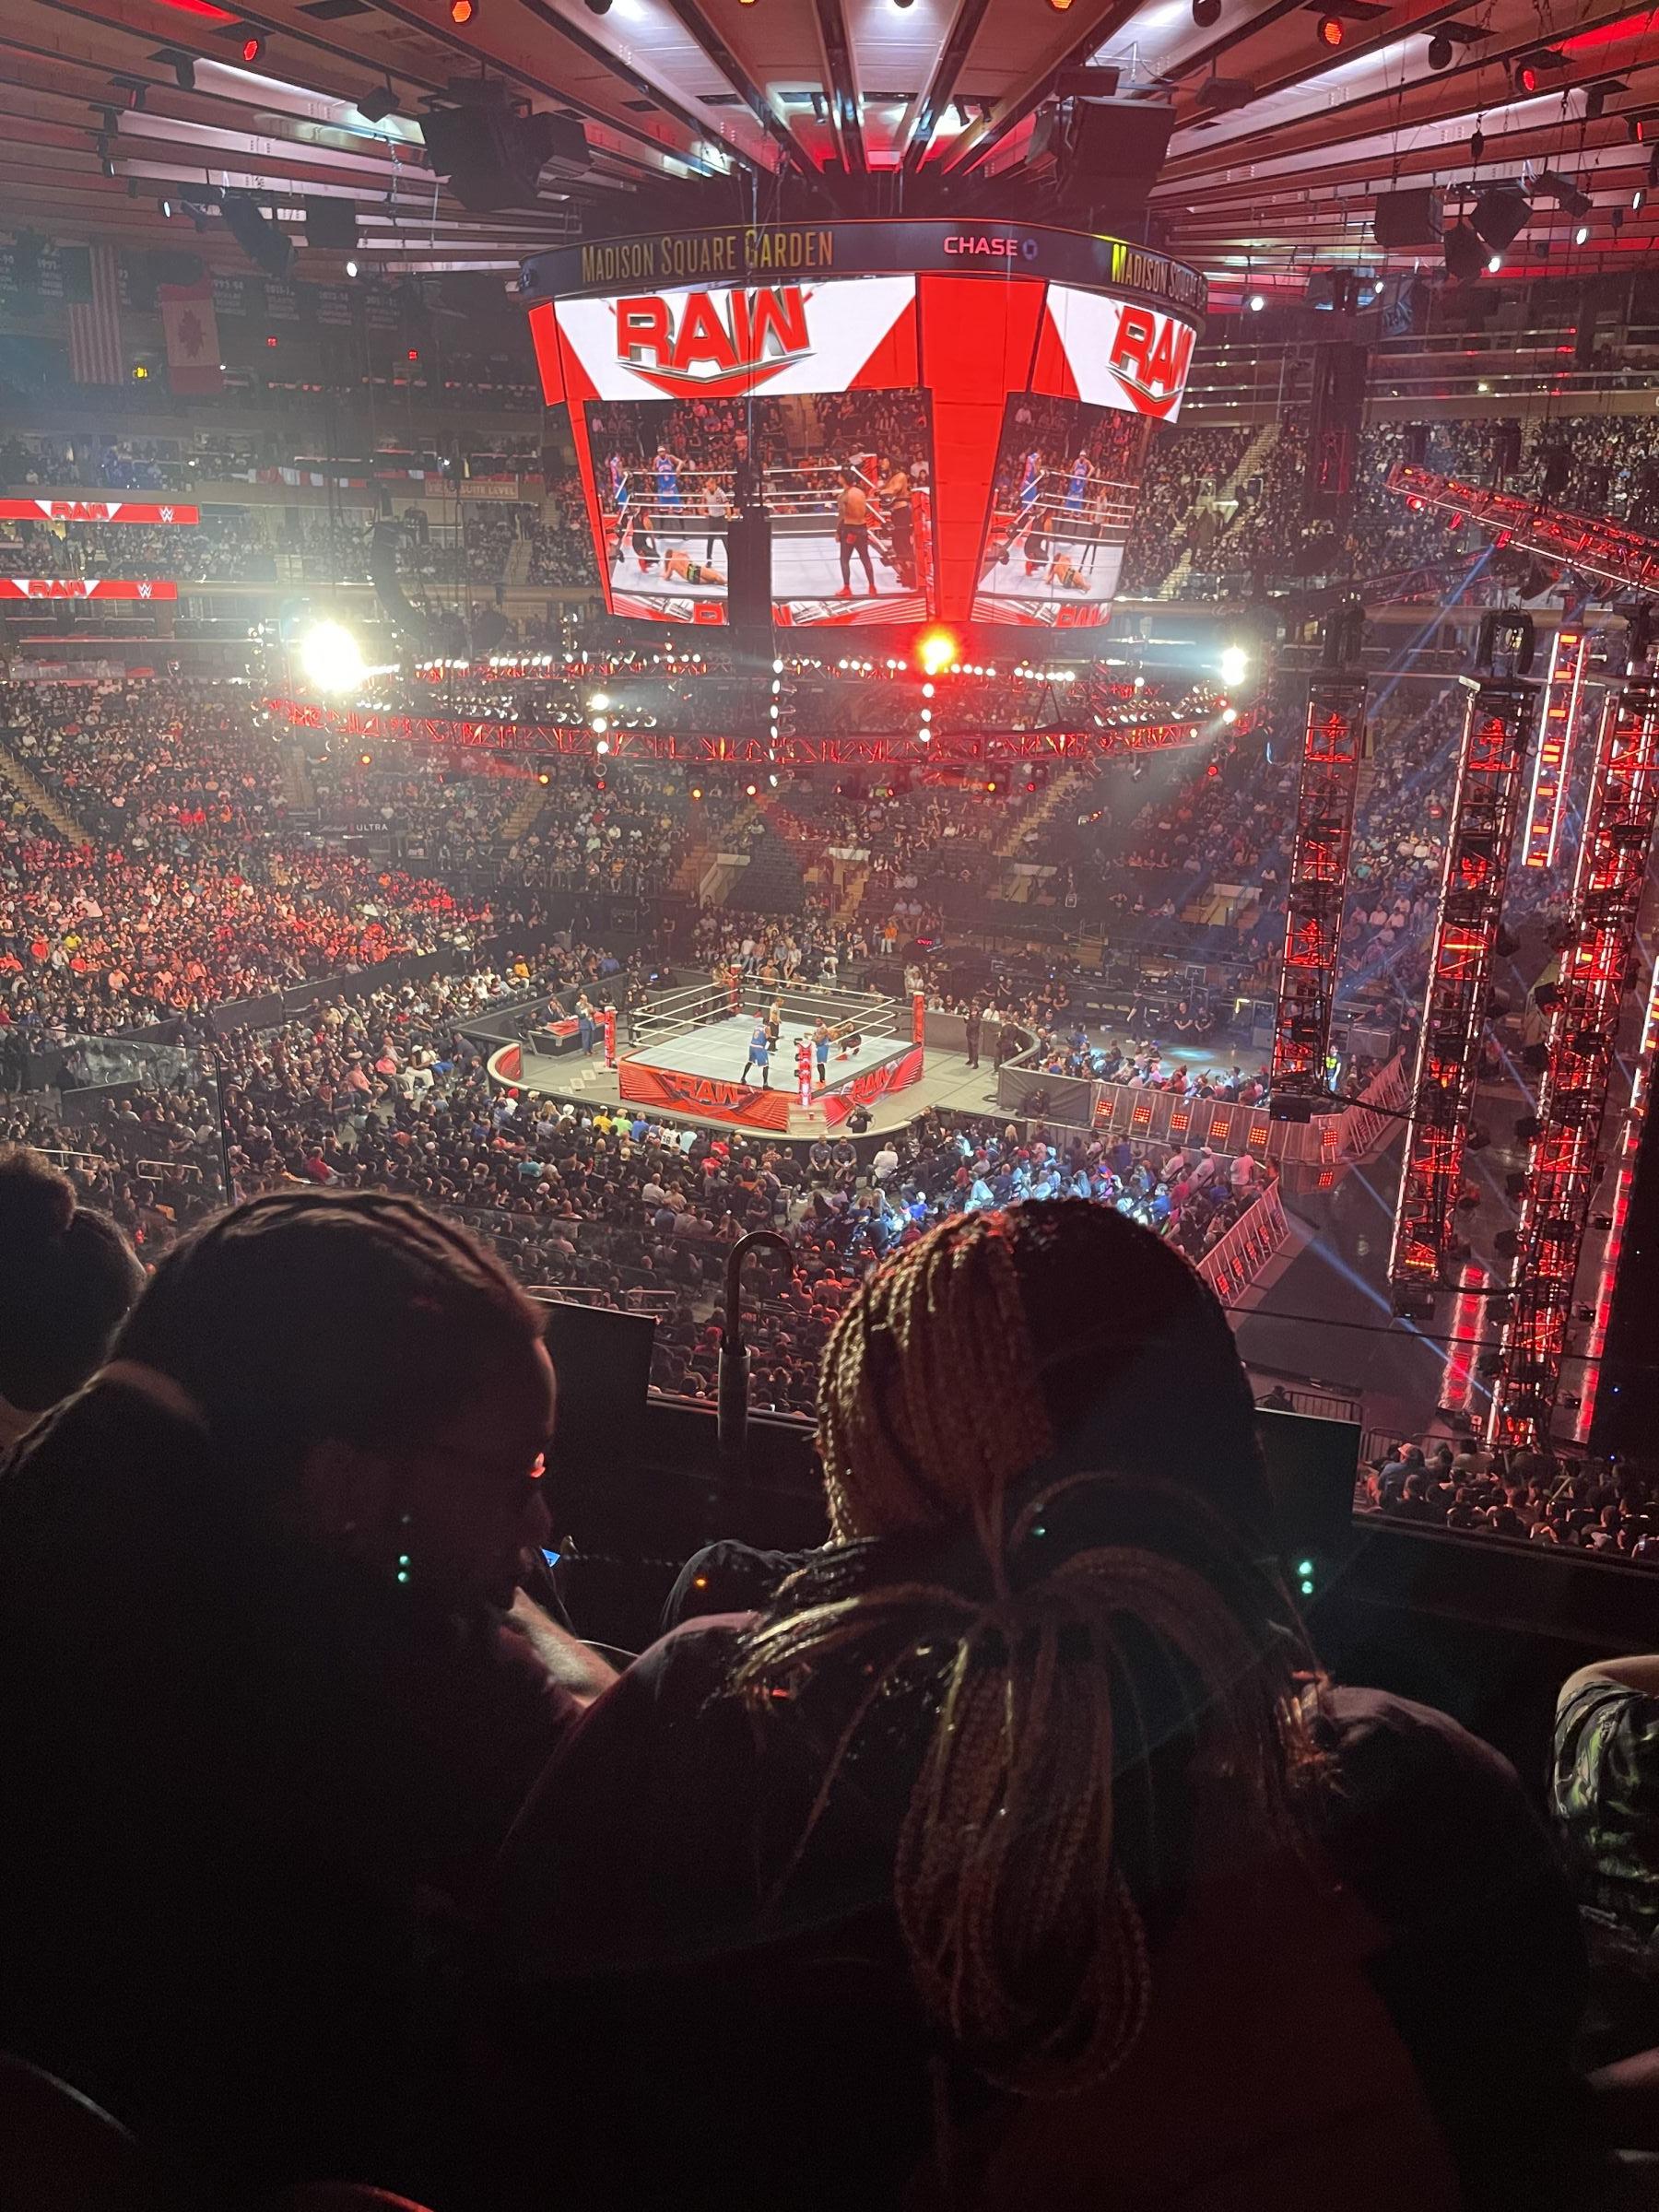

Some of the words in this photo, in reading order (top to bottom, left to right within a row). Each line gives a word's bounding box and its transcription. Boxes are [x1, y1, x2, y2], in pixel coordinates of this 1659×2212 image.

[943, 236, 1018, 256] CHASE
[617, 285, 811, 372] RAW
[1109, 305, 1194, 393] RAW
[50, 502, 110, 522] RAW
[29, 581, 87, 599] RAW
[356, 823, 389, 831] ULTRA
[675, 1076, 739, 1105] RAW
[852, 1065, 891, 1098] RAW
